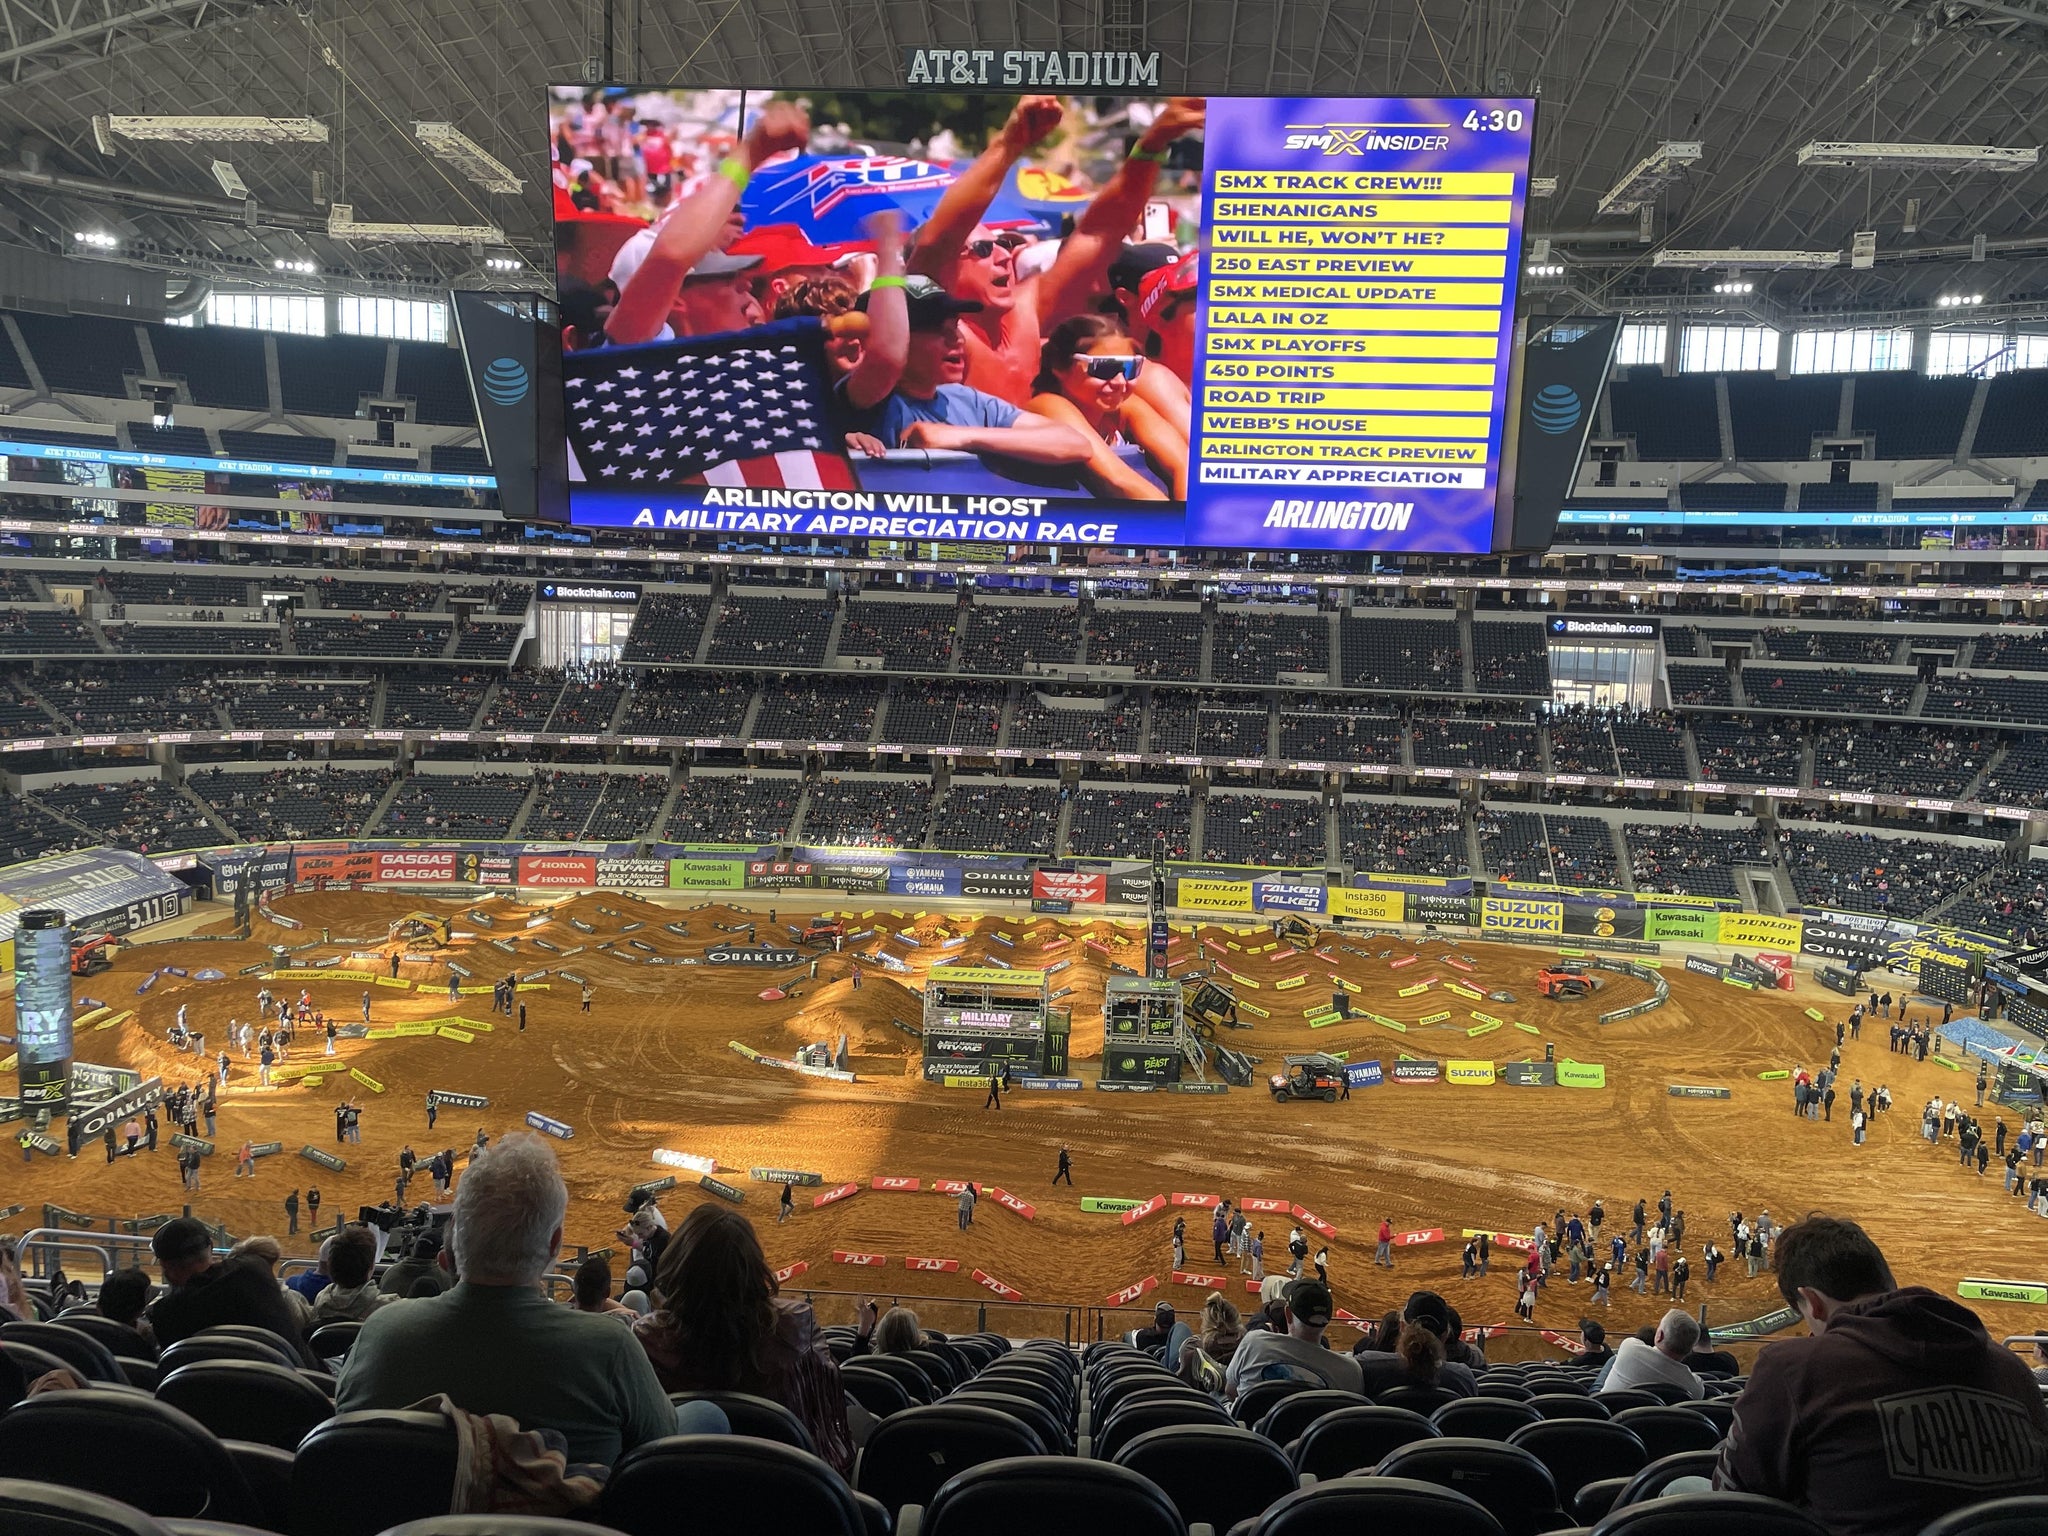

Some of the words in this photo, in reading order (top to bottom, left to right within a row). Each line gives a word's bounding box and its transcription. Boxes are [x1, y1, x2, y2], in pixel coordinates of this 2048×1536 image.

[908, 49, 994, 85] AT&T
[1003, 51, 1160, 87] STADIUM
[1462, 109, 1523, 132] 4:30
[1283, 130, 1369, 156] SMX
[1366, 135, 1450, 151] INSIDER
[1220, 175, 1267, 188] SMX
[1274, 176, 1348, 189] TRACK
[1355, 176, 1442, 191] CREW!!!
[1218, 203, 1378, 217] SHENANIGANS
[1218, 230, 1272, 243] WILL
[1279, 231, 1314, 246] HE,
[1321, 231, 1397, 244] WON'T
[1403, 232, 1445, 245] HE?
[1215, 258, 1251, 271] 250
[1258, 259, 1310, 271] EAST
[1316, 260, 1413, 272] PREVIEW
[1214, 285, 1256, 297] SMX
[1262, 286, 1350, 299] MEDICAL
[1357, 287, 1436, 300] UPDATE
[1213, 311, 1266, 324] LALA
[1273, 312, 1293, 324] IN
[1299, 312, 1328, 325] OZ
[1212, 338, 1255, 350] SMX
[1261, 338, 1366, 352] PLAYOFFS
[1210, 365, 1249, 376] 450
[1256, 365, 1335, 378] POINTS
[1209, 391, 1271, 403] ROAD
[1277, 391, 1325, 404] TRIP
[1208, 416, 1290, 430] WEBB'S
[1296, 418, 1367, 431] HOUSE
[44, 448, 65, 456] AT&T
[66, 449, 101, 460] STADIUM
[1205, 443, 1313, 456] ARLINGTON
[1319, 445, 1382, 458] TRACK
[1388, 446, 1477, 459] PREVIEW
[218, 461, 238, 469] AT&T
[239, 463, 272, 472] STADIUM
[401, 474, 433, 482] STADIUM
[1205, 467, 1301, 480] MILITARY
[1306, 469, 1462, 484] APPRECIATION
[702, 487, 876, 512] ARLINGTON
[883, 493, 959, 515] WILL
[967, 496, 1048, 517] HOST
[1263, 499, 1415, 531] ARLINGTON
[1852, 515, 1872, 523] AT&T
[1873, 515, 1909, 523] STADIUM
[632, 508, 655, 526] A
[663, 509, 804, 532] MILITARY
[806, 513, 1029, 540] APPRECIATION
[1036, 522, 1118, 542] RACE
[556, 586, 636, 600] Blockchain.com
[1567, 621, 1653, 634] Blockchain.com
[159, 733, 191, 742] MILITARY
[373, 731, 403, 739] MILITARY
[14, 741, 45, 750] MILITARY
[1115, 753, 1141, 761] MILITARY
[1490, 771, 1519, 779] MILITARY
[1695, 783, 1726, 791] MILITARY
[1840, 793, 1874, 802] MILITARY
[1996, 807, 2031, 818] MILITARY
[303, 858, 333, 868] KTM
[345, 857, 372, 866] KTM
[381, 855, 453, 868] GASGAS
[683, 863, 731, 872] Kawasaki
[752, 864, 764, 872] QT
[774, 864, 786, 872] QT
[796, 864, 808, 872] QT
[851, 866, 883, 874] amazon
[346, 870, 372, 879] KTM
[381, 869, 453, 880] GASGAS
[915, 869, 945, 878] YAMAHA
[982, 873, 1030, 881] OAKLEY
[1056, 874, 1098, 884] FLY
[683, 877, 731, 886] Kawasaki
[832, 877, 873, 886] MONSTER
[914, 882, 944, 892] YAMAHA
[982, 887, 1030, 895] OAKLEY
[1056, 887, 1097, 897] FLY
[1193, 883, 1248, 892] DUNLOP
[1261, 884, 1320, 895] FALKEN
[1192, 898, 1247, 907] DUNLOP
[1262, 895, 1320, 907] FALKEN
[1345, 892, 1387, 902] Insta360
[1420, 895, 1466, 906] MONSTER
[1652, 896, 1713, 906] DUNLOP
[1345, 906, 1386, 917] Insta360
[1486, 900, 1559, 916] SUZUKI
[127, 898, 162, 930] 5.11
[1420, 910, 1466, 921] MONSTER
[1655, 912, 1705, 923] Kawasaki
[1843, 915, 1865, 924] FORT
[1485, 915, 1559, 931] SUZUKI
[1736, 918, 1798, 931] DUNLOP
[1654, 927, 1704, 938] Kawasaki
[1827, 928, 1887, 946] OAKLEY
[1735, 933, 1797, 947] DUNLOP
[732, 954, 796, 963] OAKLEY
[1911, 945, 1969, 969] alpinestars
[951, 970, 1040, 981] DUNLOP
[1279, 978, 1303, 989] SUZUKI
[1242, 1003, 1268, 1018] SUZUKI
[1305, 1004, 1333, 1017] SUZUKI
[960, 1012, 1013, 1023] MILITARY
[1422, 1013, 1449, 1025] SUZUKI
[310, 1063, 337, 1072] Insta360
[1144, 1058, 1170, 1070] BEAST
[1354, 1066, 1382, 1078] YAMAHA
[1450, 1069, 1493, 1077] SUZUKI
[1564, 1071, 1600, 1080] Kawasaki
[23, 1084, 66, 1100] SMX
[106, 1086, 162, 1124] OAKLEY
[442, 1095, 482, 1107] OAKLEY
[882, 1178, 909, 1188] FLY
[822, 1187, 846, 1203] FLY
[1182, 1195, 1210, 1205] FLY
[1001, 1194, 1027, 1211] FLY
[1252, 1200, 1279, 1210] FLY
[1132, 1200, 1154, 1219] FLY
[1302, 1212, 1328, 1229] FLY
[1406, 1231, 1433, 1244] FLY
[844, 1254, 874, 1265] FLY
[917, 1259, 947, 1270] FLY
[982, 1278, 1011, 1295] FLY
[1184, 1275, 1216, 1287] FLY
[1120, 1283, 1144, 1303] FLY
[1979, 1286, 2031, 1302] Kawasaki
